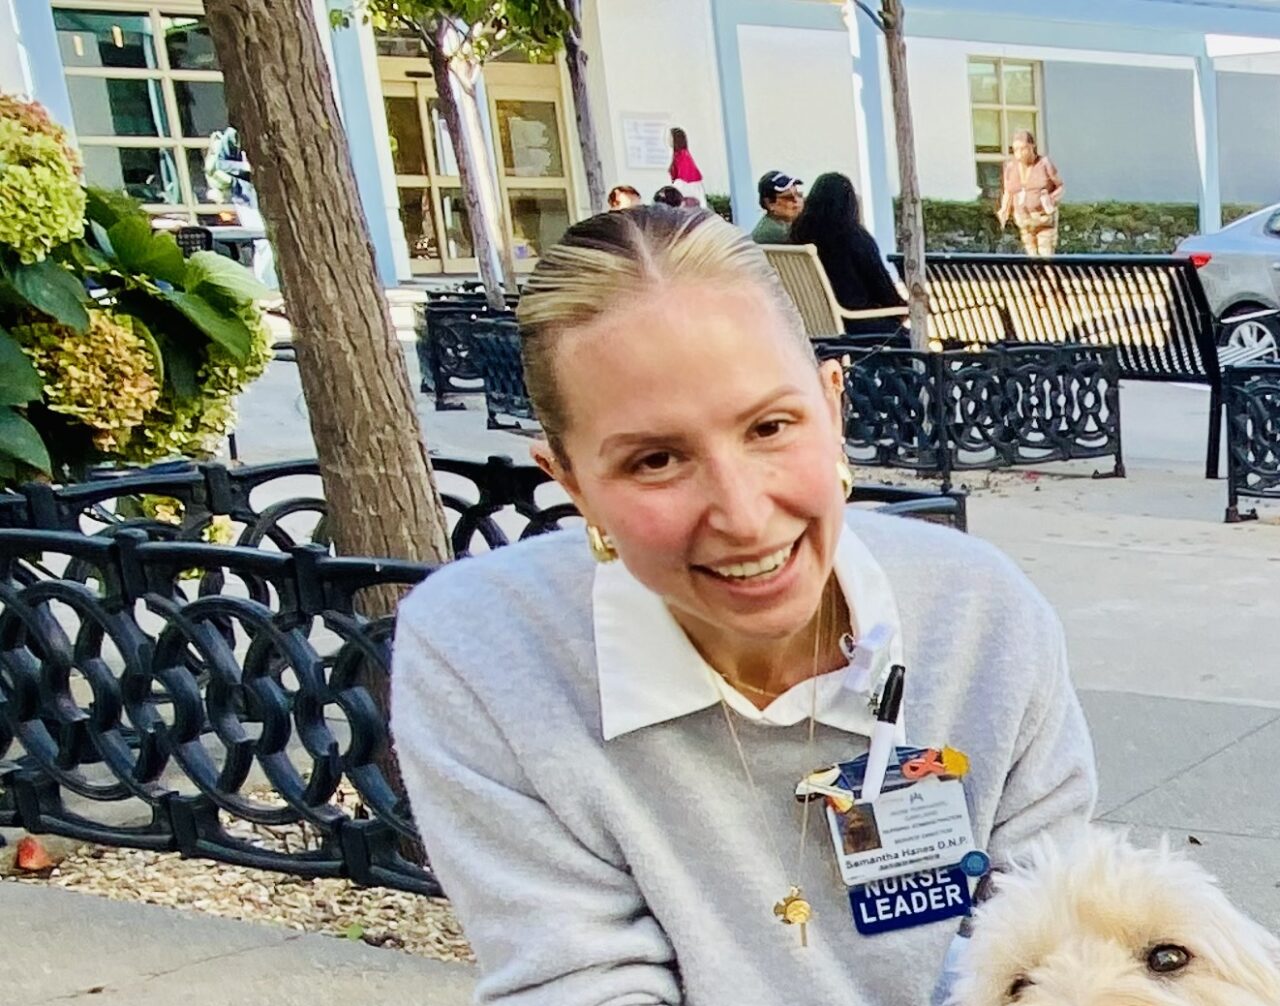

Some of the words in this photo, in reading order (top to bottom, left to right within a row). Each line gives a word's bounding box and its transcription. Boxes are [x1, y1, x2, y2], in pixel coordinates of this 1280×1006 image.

[846, 851, 899, 869] Samantha
[864, 868, 952, 899] NURSE
[860, 884, 963, 924] LEADER
